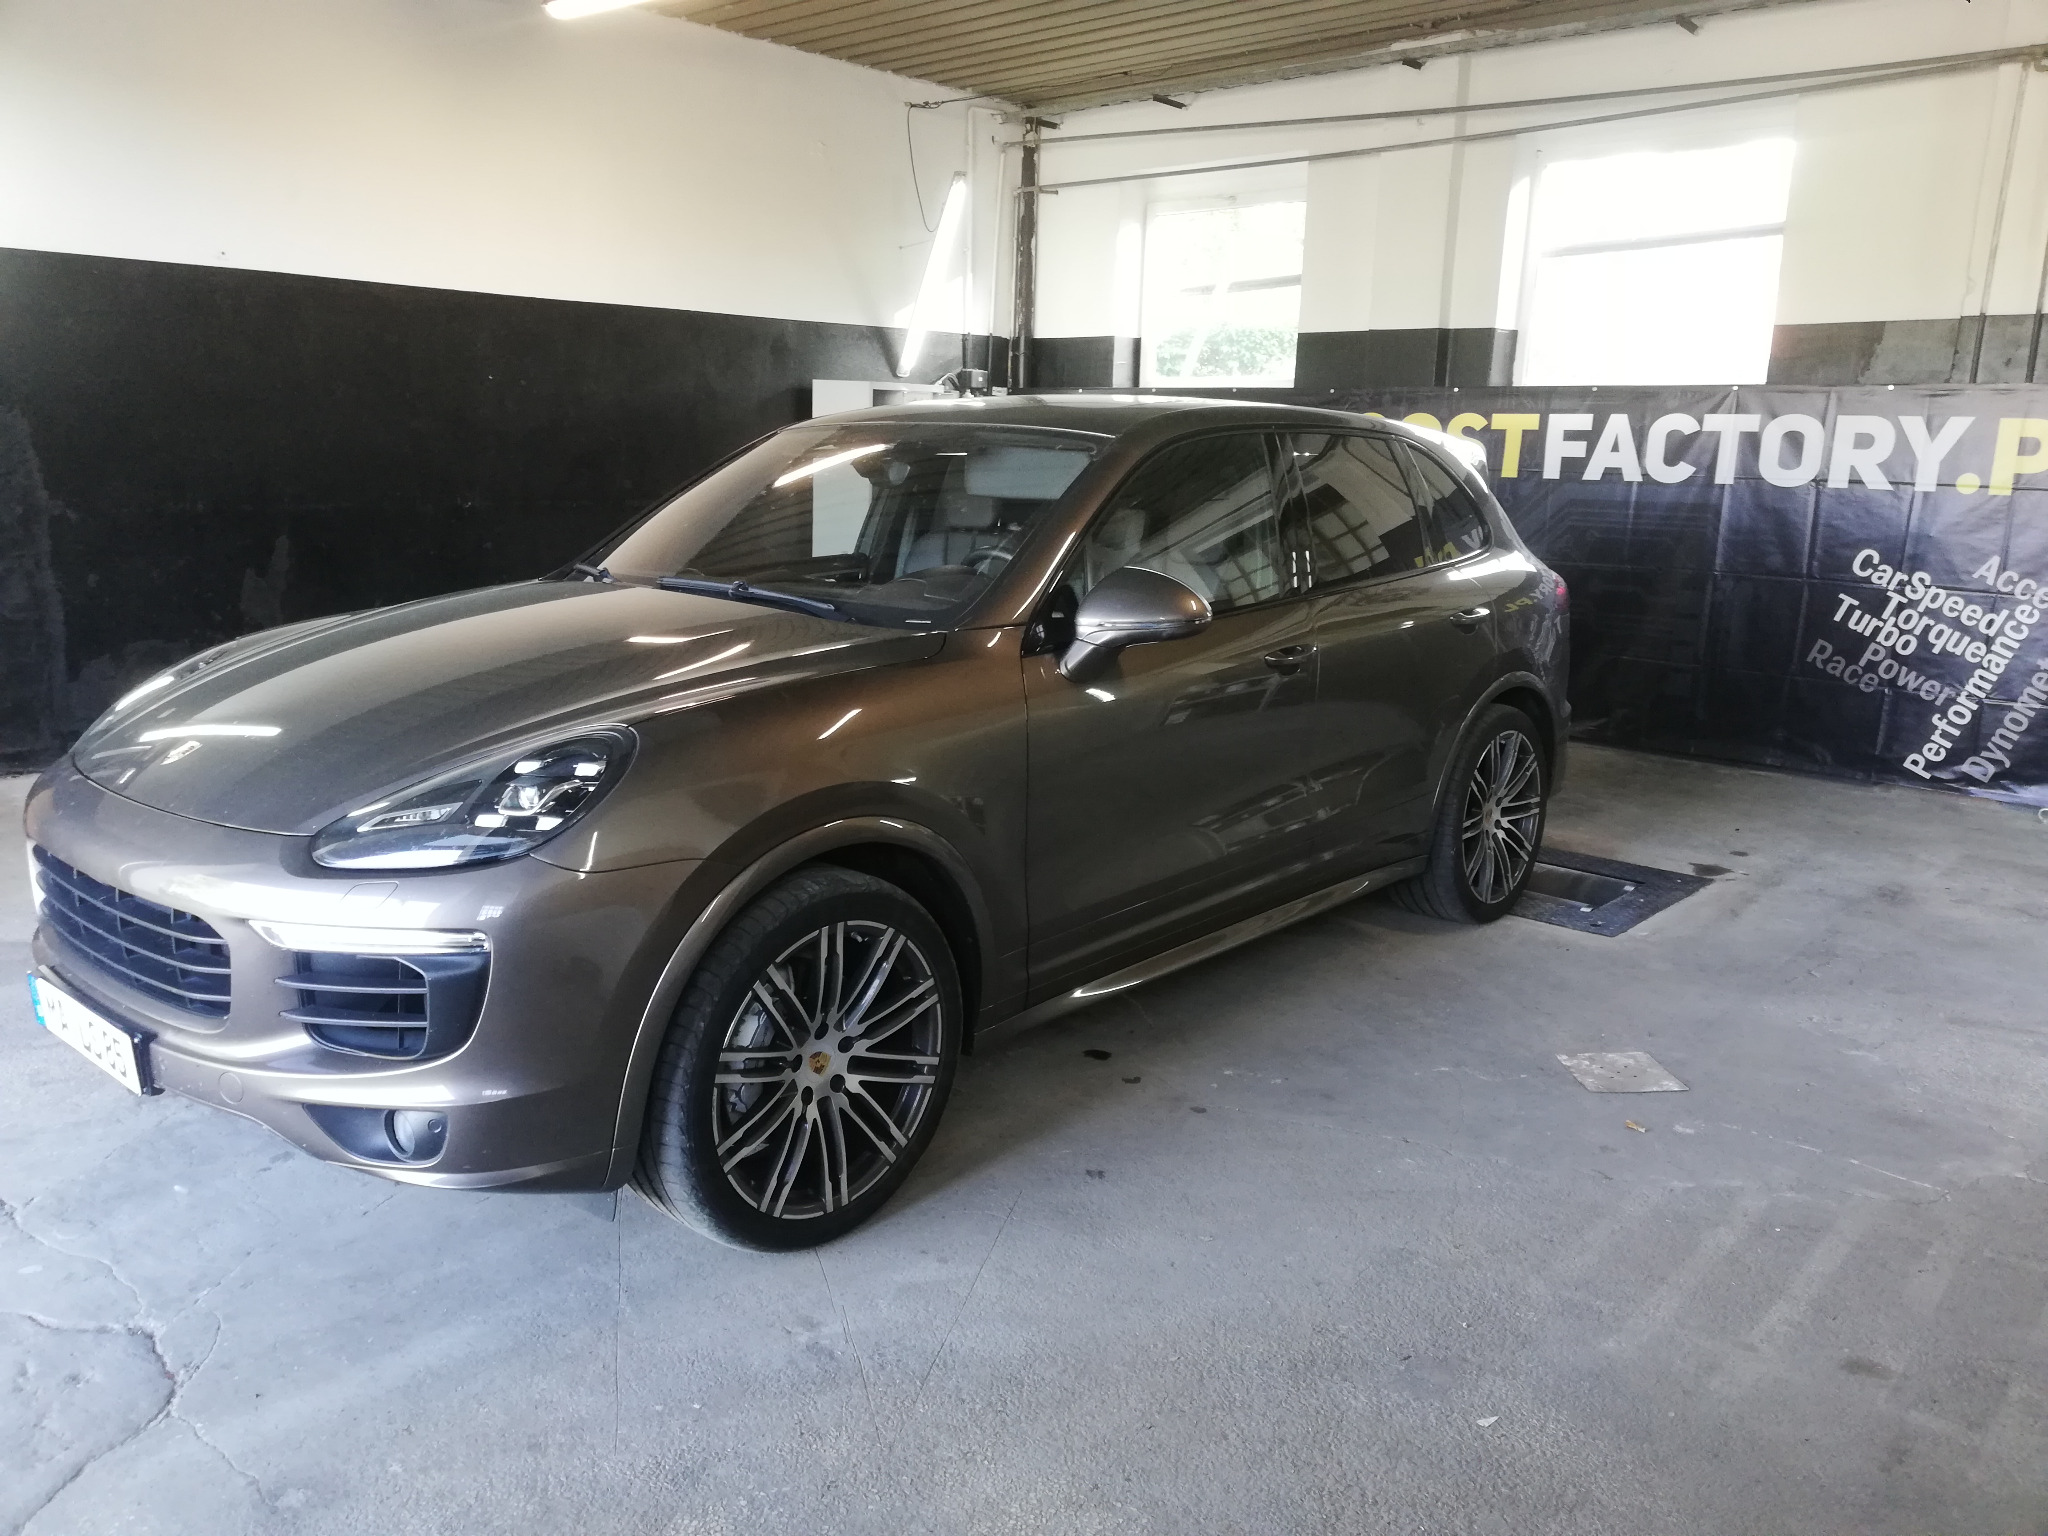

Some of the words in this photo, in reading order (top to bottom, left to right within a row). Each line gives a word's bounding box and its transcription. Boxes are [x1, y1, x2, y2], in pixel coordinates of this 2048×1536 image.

[1832, 592, 1918, 656] Turbo
[1880, 590, 1988, 664] Torque
[1806, 638, 1880, 693] Race
[1858, 641, 1957, 707] Power
[1902, 603, 2041, 780] Performance
